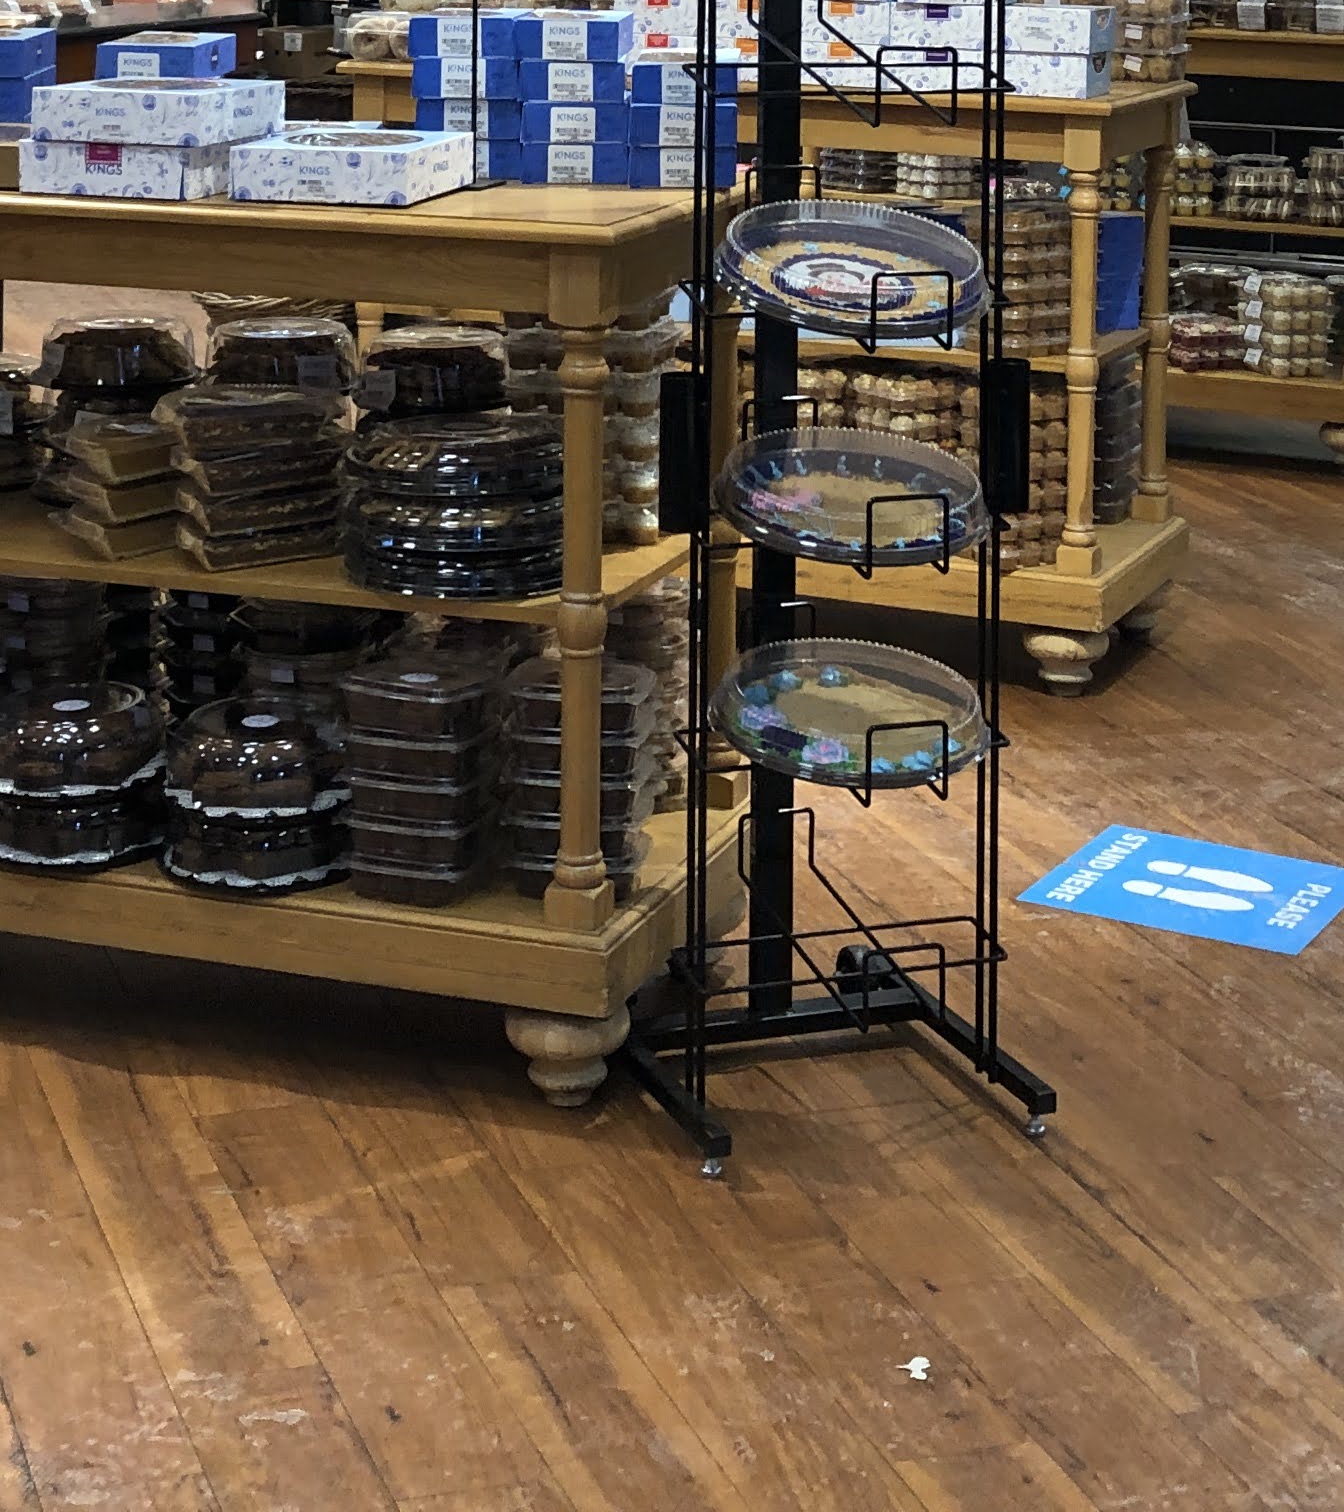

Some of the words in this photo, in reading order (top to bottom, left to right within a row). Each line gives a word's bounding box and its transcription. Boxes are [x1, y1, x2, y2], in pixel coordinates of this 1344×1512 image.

[550, 26, 580, 36] KINGS
[123, 58, 153, 68] KINGS
[447, 64, 477, 74] KING
[555, 68, 586, 78] KINGS
[95, 106, 125, 117] KINGS
[667, 111, 696, 121] KING
[557, 113, 588, 122] KINGS
[555, 151, 586, 160] KINGS
[667, 154, 696, 163] KING
[85, 163, 123, 176] KINGS
[299, 166, 331, 177] KINGS
[1087, 832, 1149, 871] STAND
[1046, 868, 1104, 904] HERE
[1266, 882, 1333, 930] PLEASE
